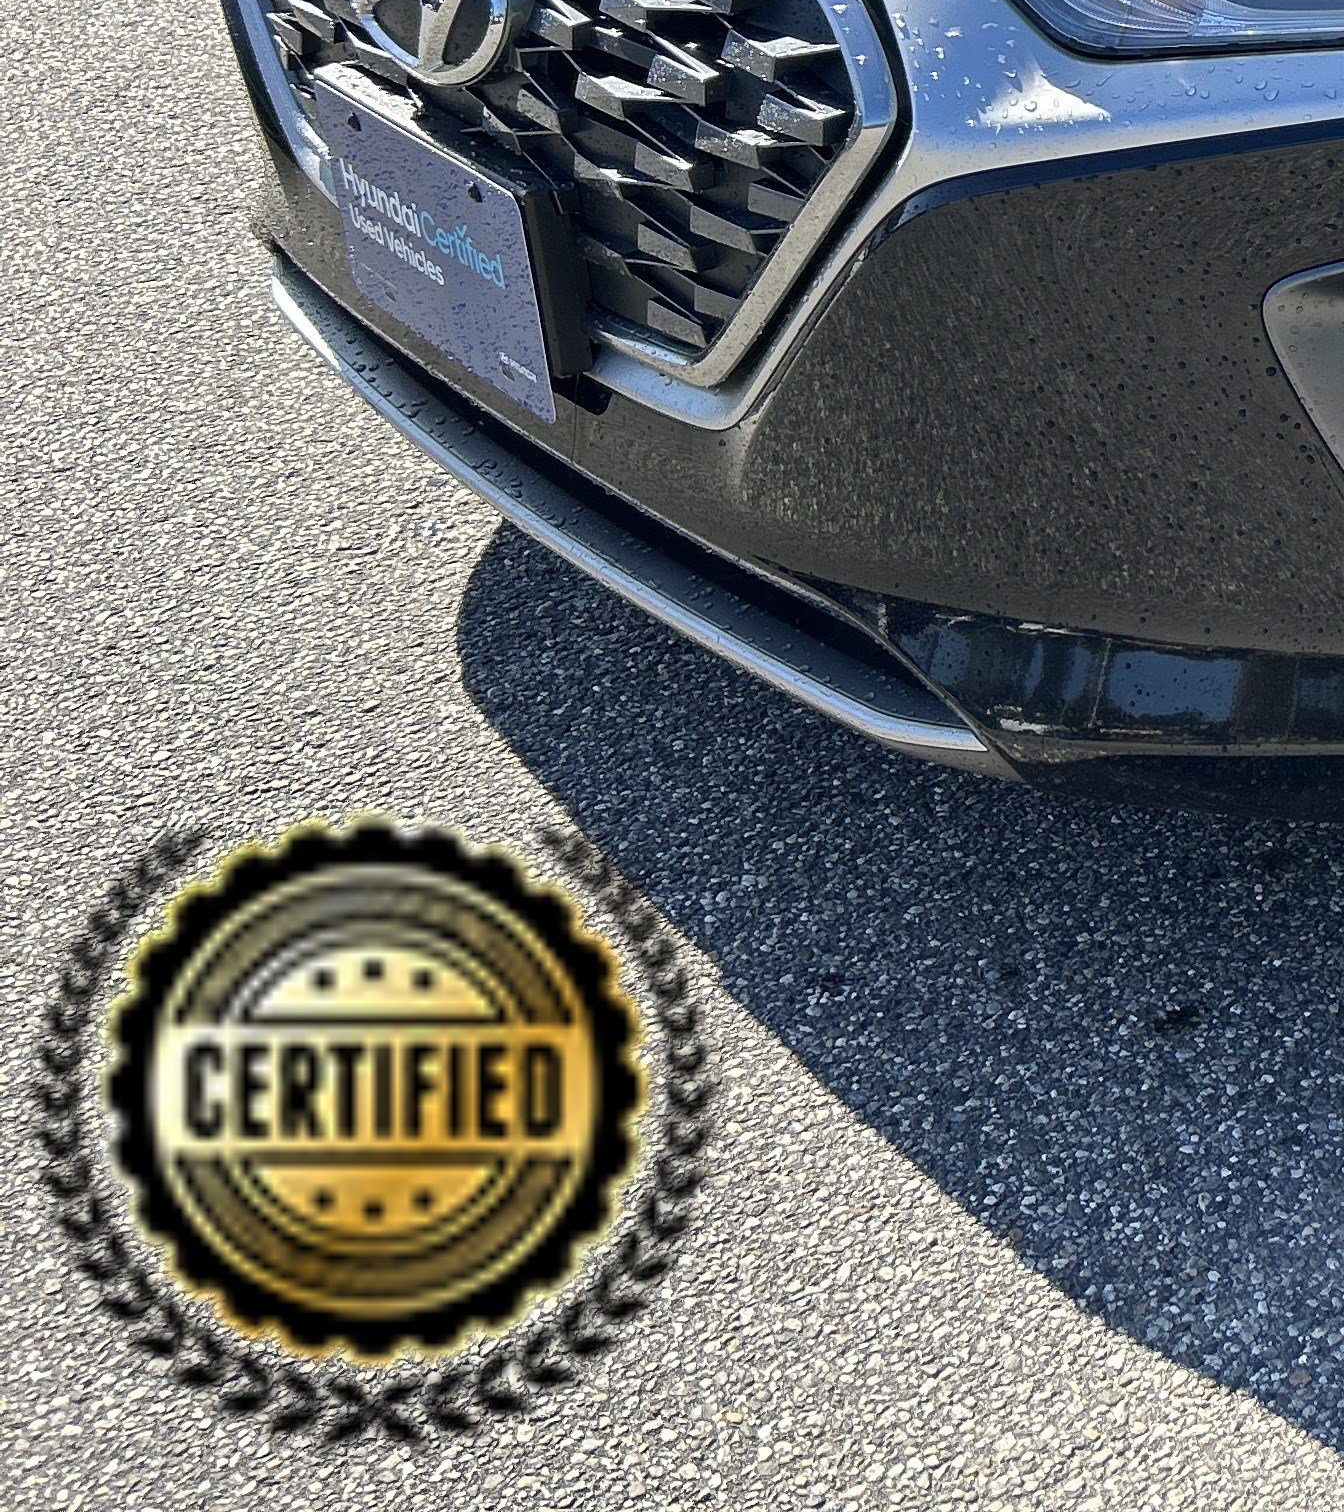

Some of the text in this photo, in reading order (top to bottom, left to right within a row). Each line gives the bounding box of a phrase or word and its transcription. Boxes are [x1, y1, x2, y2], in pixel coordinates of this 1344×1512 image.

[339, 157, 506, 289] Hyundai Certified
[348, 202, 445, 286] Used Vehicles
